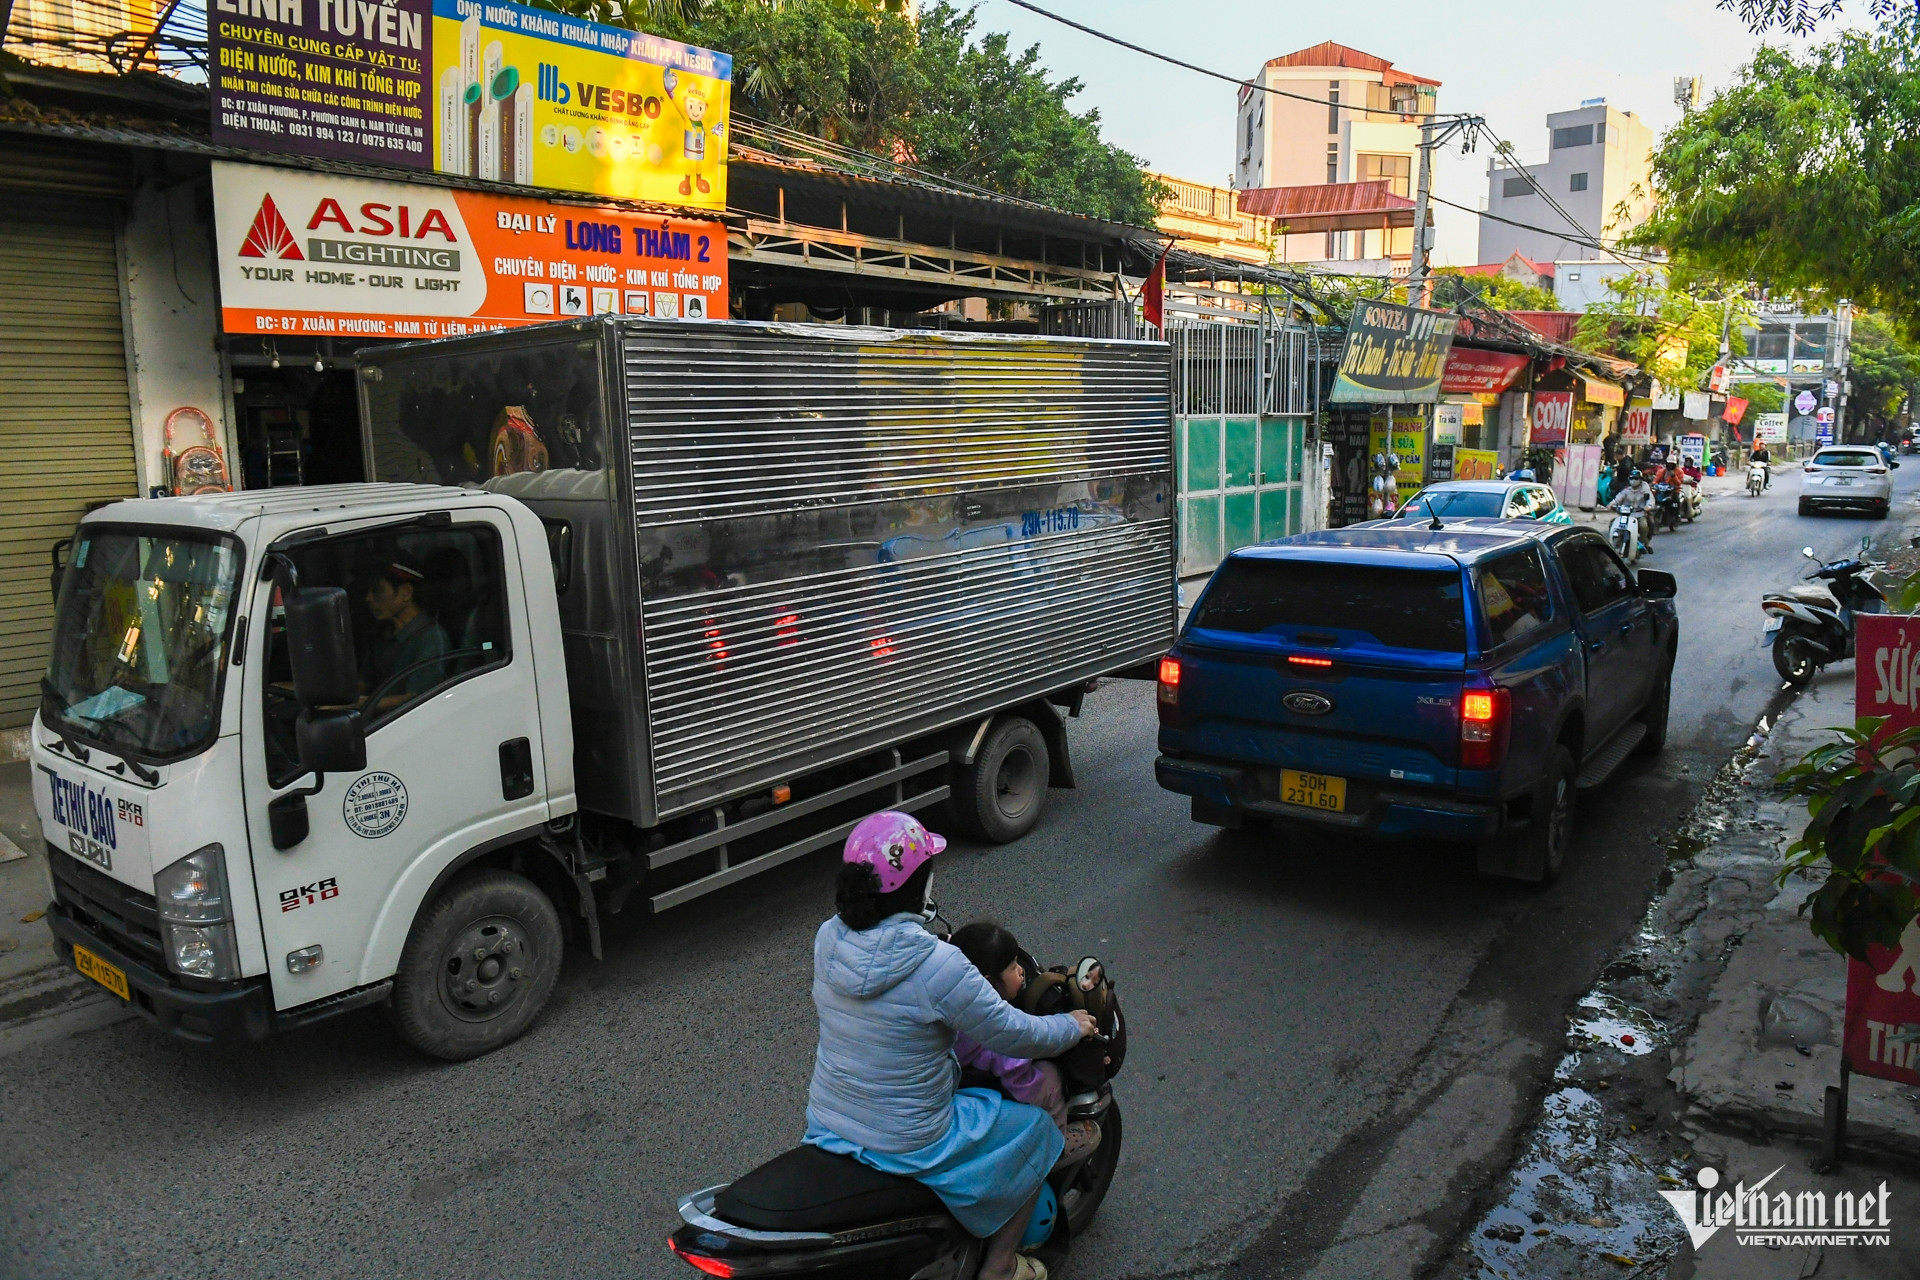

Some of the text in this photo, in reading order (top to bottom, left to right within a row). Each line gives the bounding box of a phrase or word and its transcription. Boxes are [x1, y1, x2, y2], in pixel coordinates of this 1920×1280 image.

[217, 0, 302, 26] NH
[220, 22, 284, 49] CHUYÊN
[288, 36, 330, 55] CUNG
[335, 42, 364, 60] CẤP
[370, 49, 394, 67] VẬT
[486, 2, 517, 27] NƯỚC
[521, 12, 558, 36] KHÁNG
[562, 22, 598, 45] KHUẨN
[601, 33, 628, 54] NHẬP
[659, 47, 682, 64] PP-R
[220, 47, 421, 102] ĐIỆN NƯỚC, KIM KHÍ TỔNG HỢP
[221, 76, 422, 120] NHẬN THI CÔNG SỬA CHỮA CÁC CÔNG TRÌNH ĐIỆN NƯỚC
[221, 97, 235, 109] ĐC:
[236, 100, 245, 110] 87
[247, 100, 268, 113] XUÂN
[303, 110, 310, 120] P.
[312, 110, 339, 124] PHƯƠNG
[341, 115, 359, 129] CANH
[360, 119, 367, 130] Q.
[369, 120, 384, 133] NAM
[386, 121, 394, 134] TỪ
[414, 126, 423, 138] HN
[222, 112, 422, 153] ĐIỆN THOẠI: 0931 994 123 / 0975 635 400
[307, 197, 457, 242] ASIA
[497, 211, 531, 235] ĐẠI
[536, 214, 557, 234] LÝ
[565, 219, 621, 254] LONG
[698, 235, 710, 262] 2
[321, 242, 450, 268] LIGHTING
[241, 266, 294, 281] YOUR
[415, 278, 460, 292] LIGHT
[494, 256, 543, 277] CHUYÊN
[549, 260, 576, 283] ĐIỆN
[586, 263, 616, 283] NƯỚC
[626, 269, 646, 286] KIM
[651, 268, 668, 287] KHÍ
[673, 266, 698, 288] TỔNG
[702, 274, 722, 293] HỢP
[256, 316, 278, 330] ĐC:
[281, 317, 296, 330] 87
[302, 315, 336, 331] XUÂN
[338, 317, 385, 333] PHƯƠNG
[394, 321, 420, 334] NAM
[423, 321, 438, 334] TỪ
[441, 321, 466, 336] LIÊM
[1533, 397, 1568, 430] CƠM
[1021, 506, 1079, 536] 29K-115.70
[1287, 787, 1338, 809] 231.60
[1299, 774, 1328, 792] 50H
[88, 786, 116, 849] BÁO
[118, 798, 142, 816] QKR
[118, 810, 143, 826] 210
[380, 810, 390, 819] 3N
[279, 877, 337, 903] QKR
[281, 886, 339, 913] 210
